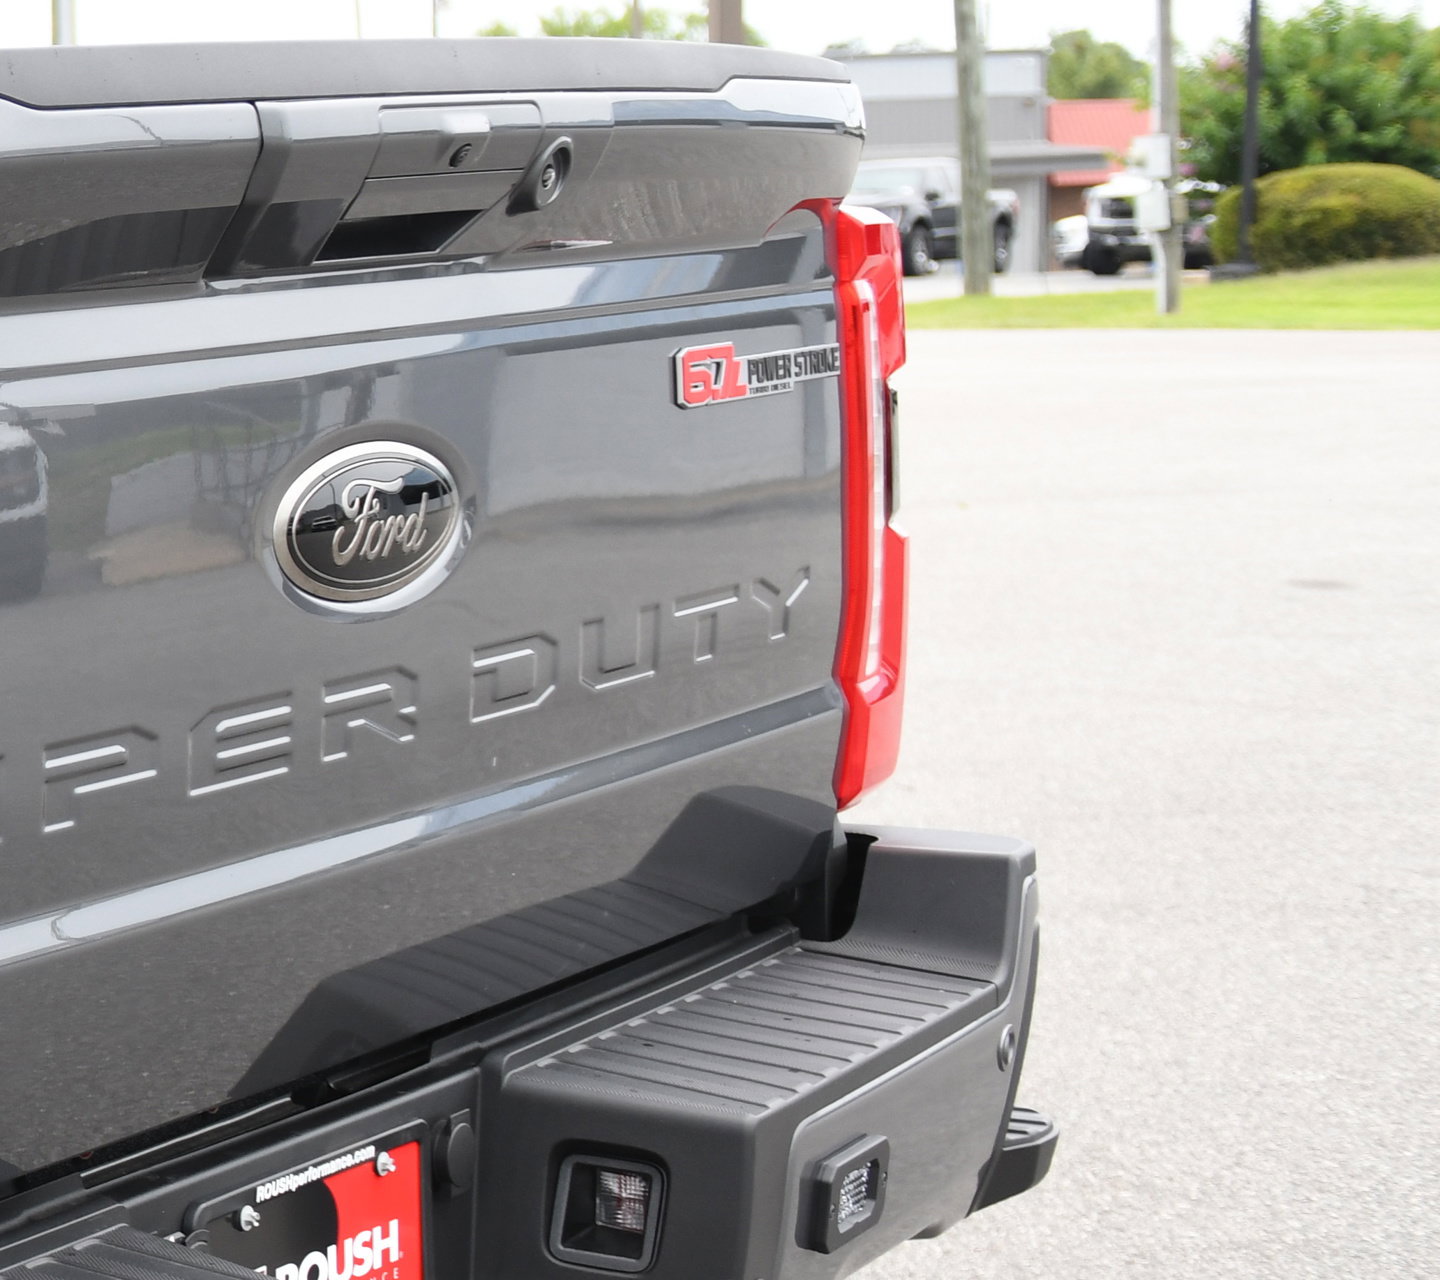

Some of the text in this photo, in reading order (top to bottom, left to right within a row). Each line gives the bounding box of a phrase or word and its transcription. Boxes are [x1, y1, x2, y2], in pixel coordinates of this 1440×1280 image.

[747, 347, 840, 385] POWER STROKE
[332, 476, 429, 566] Ford
[470, 564, 812, 724] DUTY
[256, 1145, 376, 1203] ROUSHperformance.com
